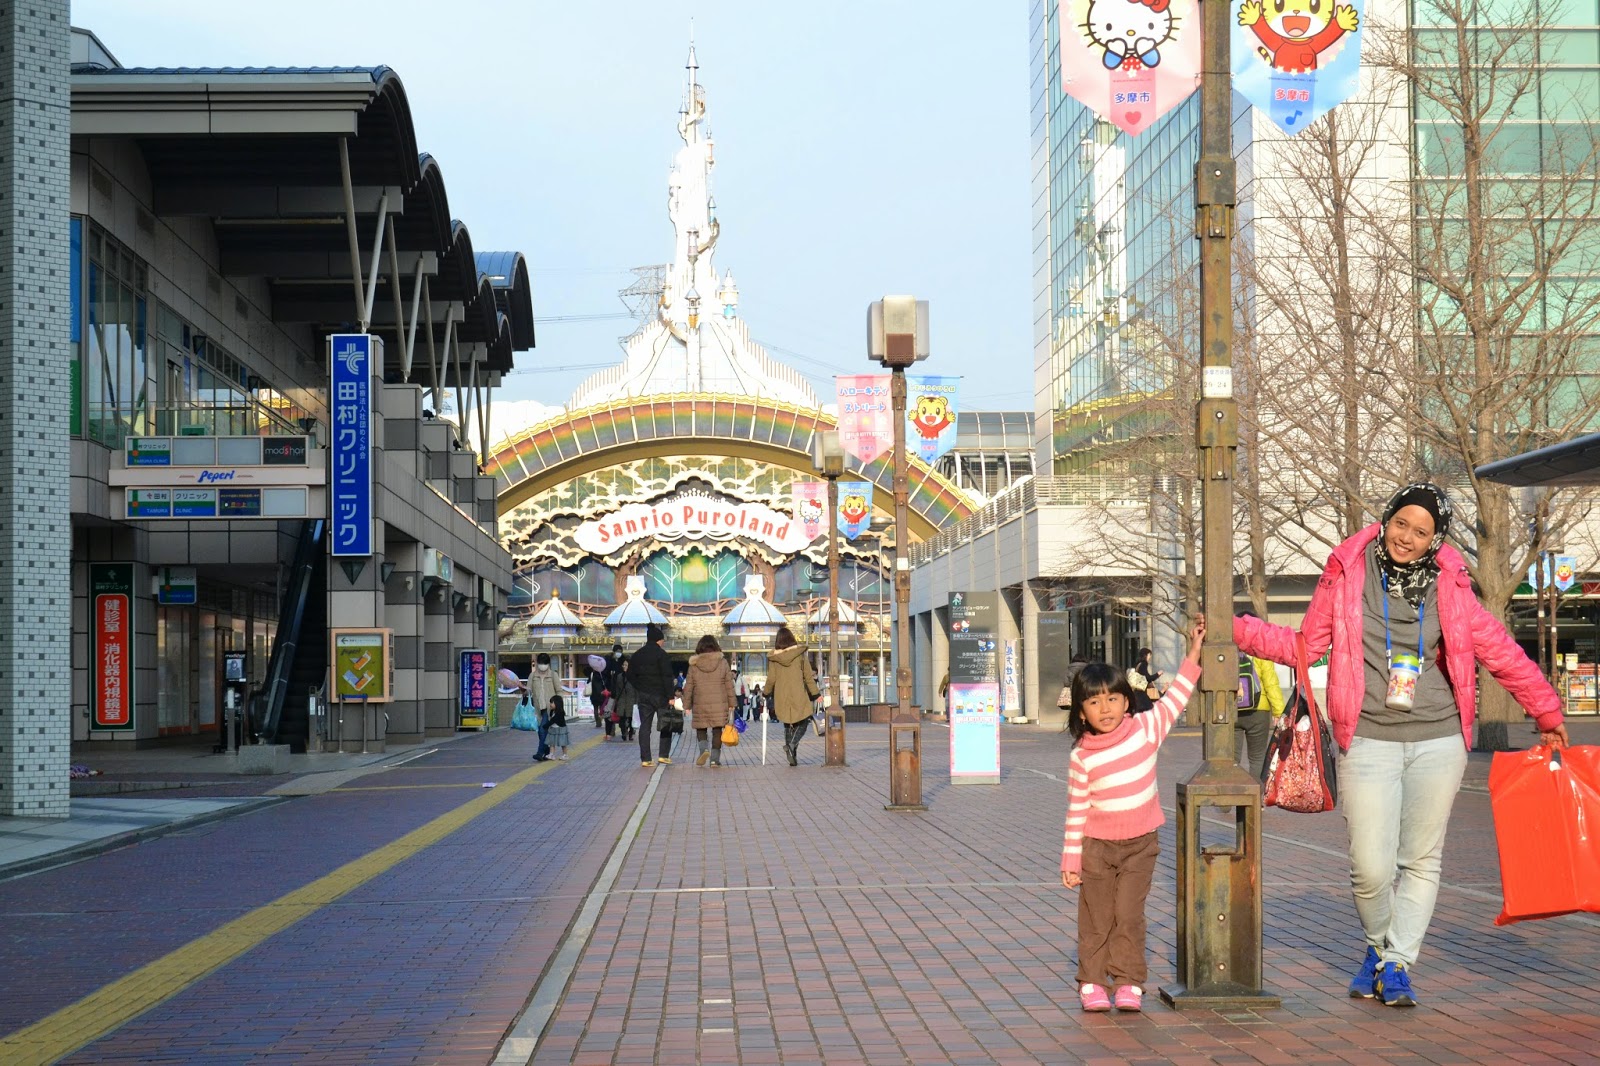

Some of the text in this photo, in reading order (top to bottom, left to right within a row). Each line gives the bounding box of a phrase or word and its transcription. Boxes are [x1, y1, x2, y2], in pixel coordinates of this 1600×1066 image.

[1115, 92, 1150, 104] 多摩市
[1274, 88, 1310, 102] 多摩市
[839, 386, 890, 397] ハローキティ
[844, 402, 887, 414] ストリート
[337, 382, 358, 546] 田村クリニック
[197, 470, 235, 483] Peperi
[598, 505, 790, 543] Sanrio Puroland
[569, 636, 616, 645] TICKETS
[104, 599, 120, 720] 健診室・消化器内視鏡室
[472, 655, 483, 706] 処方せん受付
